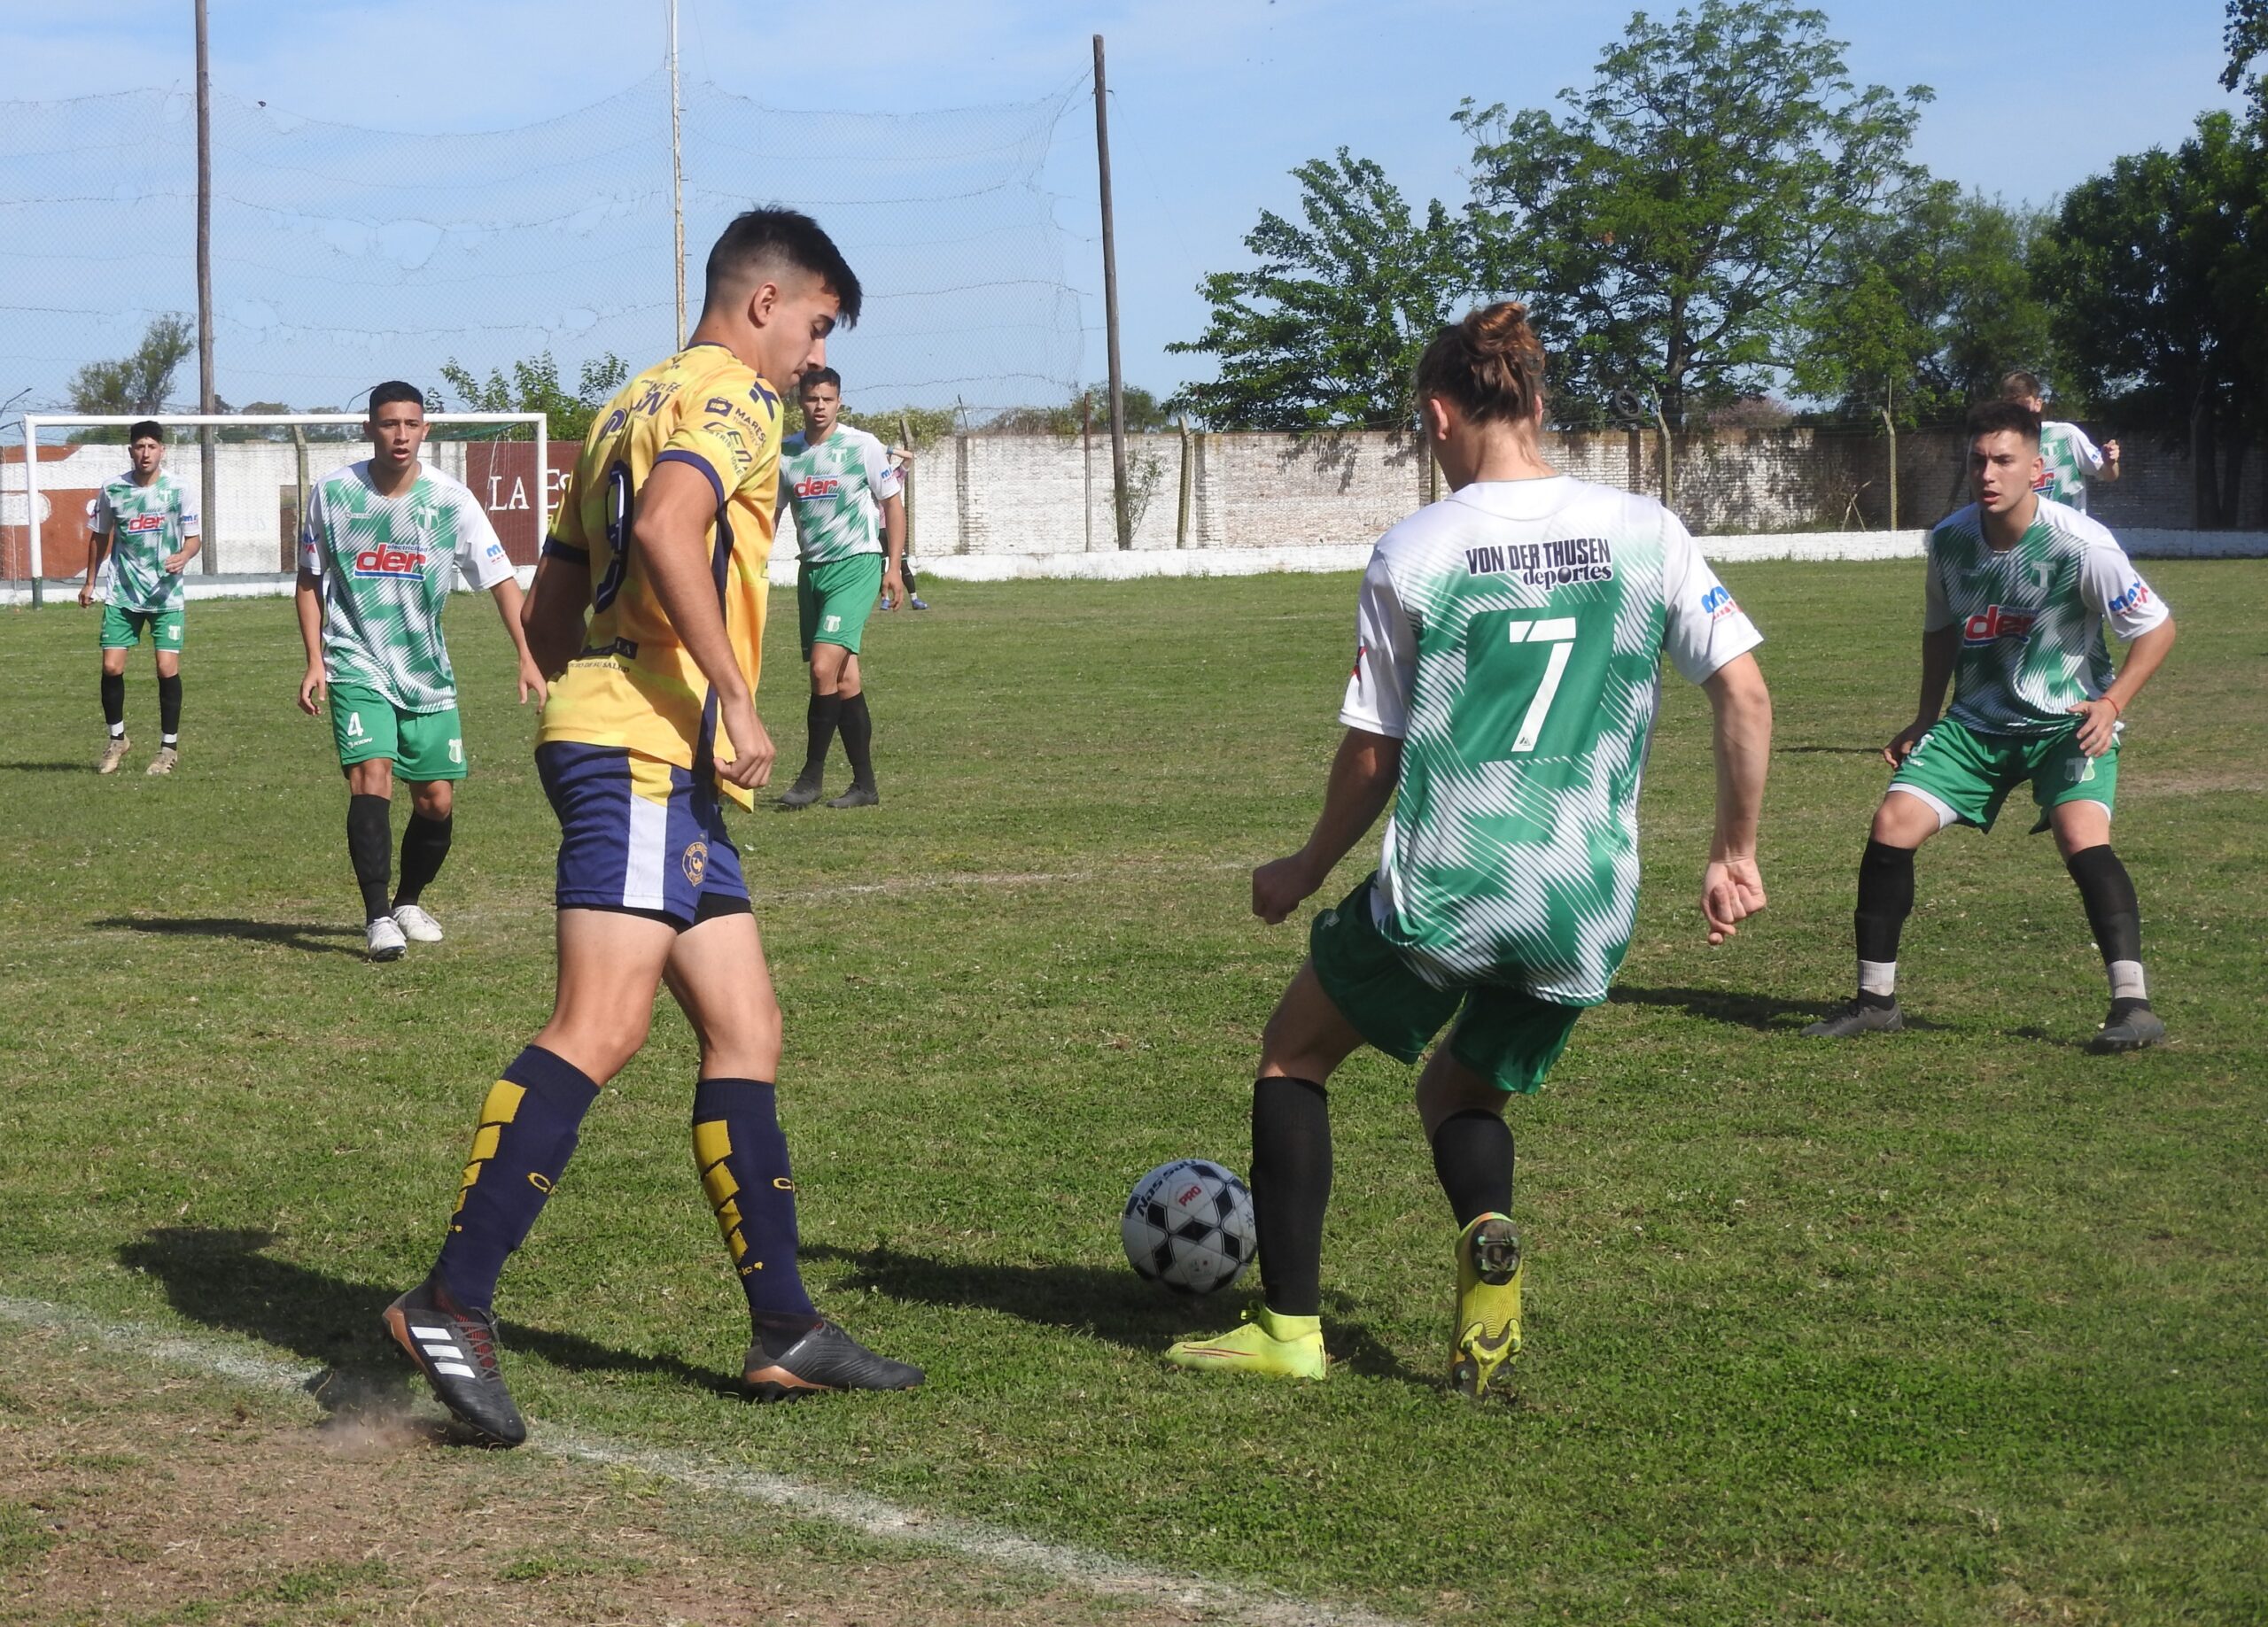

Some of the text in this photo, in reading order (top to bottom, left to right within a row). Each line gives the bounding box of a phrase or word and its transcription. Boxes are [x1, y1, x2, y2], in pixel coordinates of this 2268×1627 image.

[489, 476, 530, 511] LA
[794, 476, 838, 496] der
[128, 515, 165, 531] der
[356, 544, 426, 573] der
[1465, 538, 1612, 575] VON DER THUSEN
[1523, 563, 1612, 591] deportes
[1509, 617, 1576, 752] 7
[347, 711, 364, 737] 4
[1178, 1185, 1202, 1206] PRO
